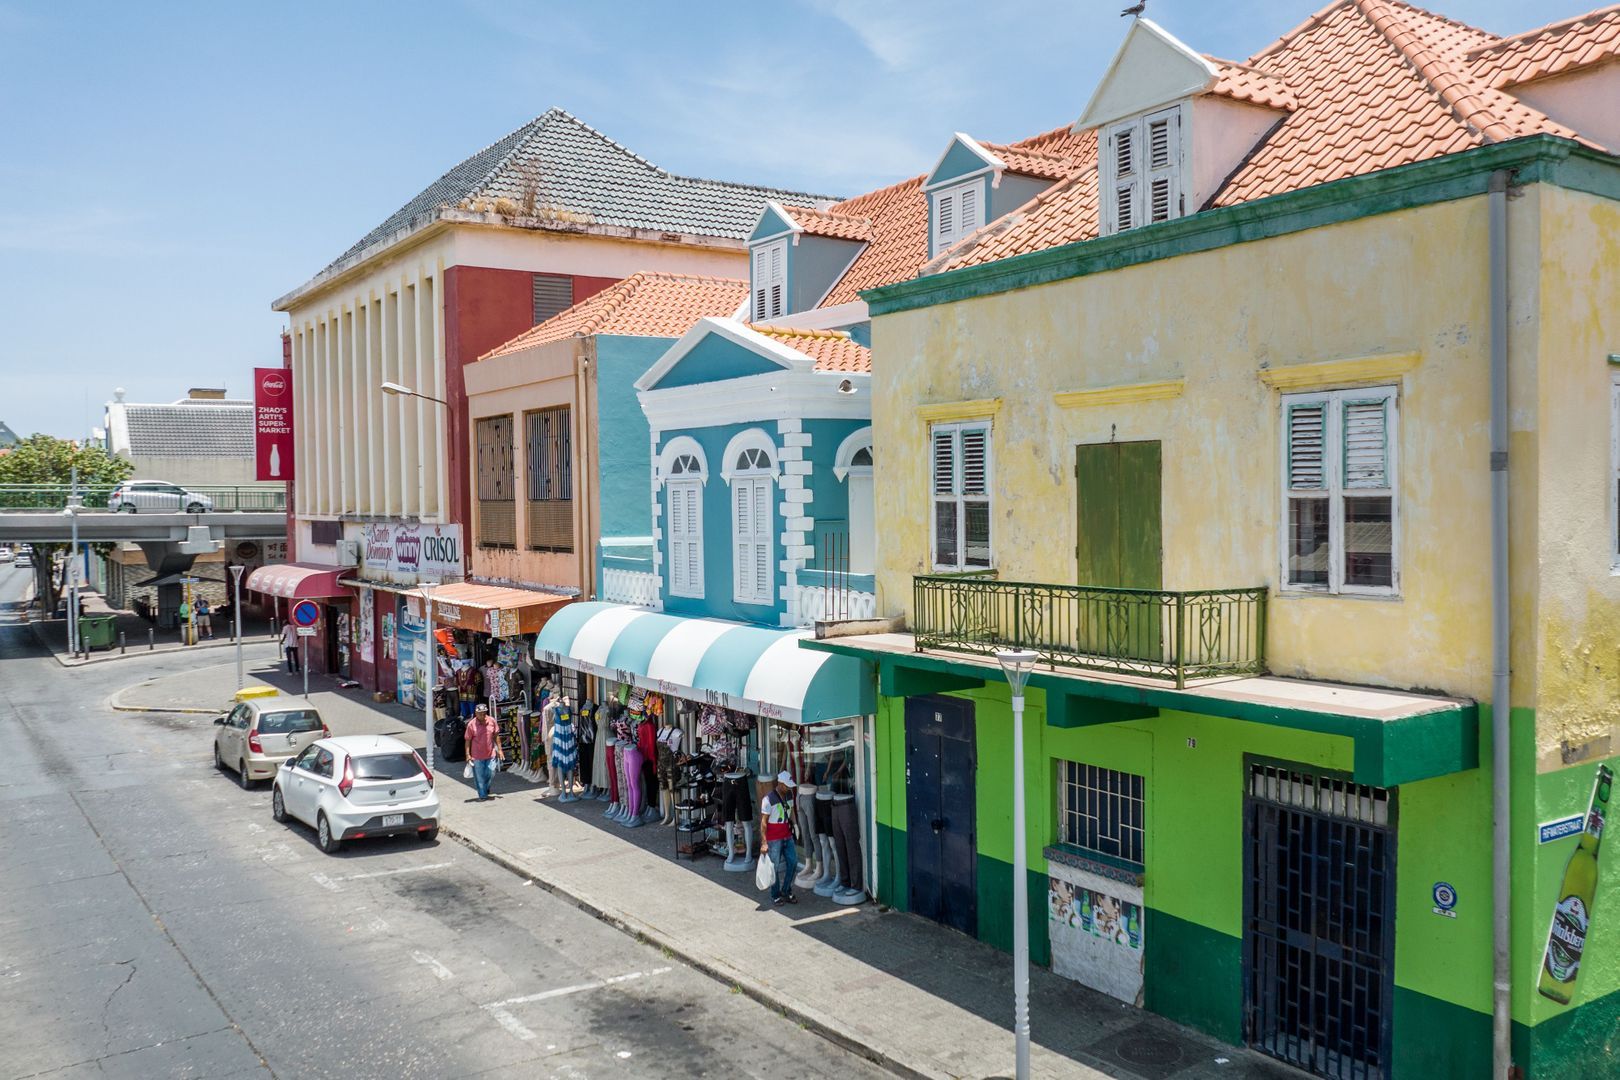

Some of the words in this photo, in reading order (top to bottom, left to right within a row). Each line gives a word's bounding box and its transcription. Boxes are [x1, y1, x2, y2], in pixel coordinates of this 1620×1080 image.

[372, 523, 390, 544] Santo
[366, 538, 394, 569] Domingo
[424, 536, 460, 563] CRISOL
[757, 700, 783, 718] Fashion
